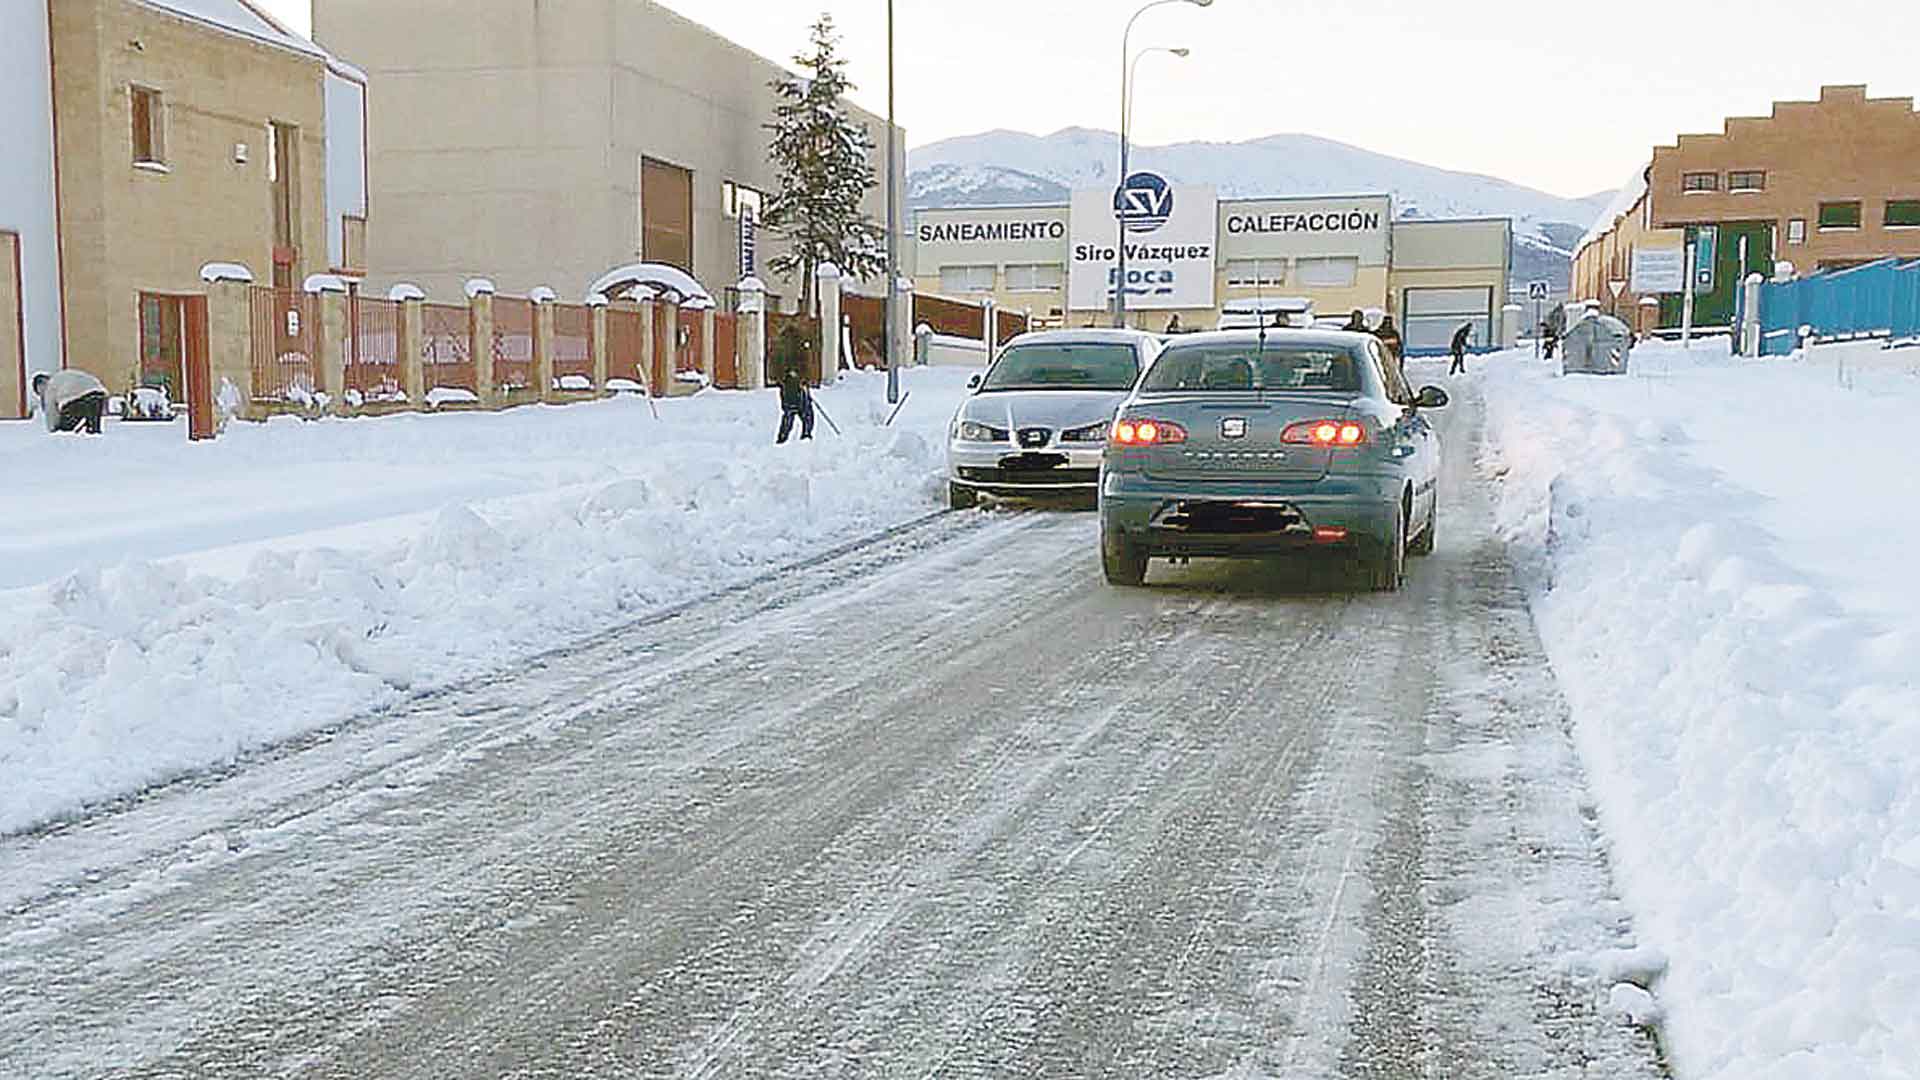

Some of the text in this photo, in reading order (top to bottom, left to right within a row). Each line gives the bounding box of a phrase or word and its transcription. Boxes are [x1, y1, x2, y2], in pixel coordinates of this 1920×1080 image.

[1228, 208, 1379, 233] CALEFACCIÓN
[919, 221, 1065, 242] SANEAMIENTO
[1075, 242, 1210, 263] Siro Vázquez
